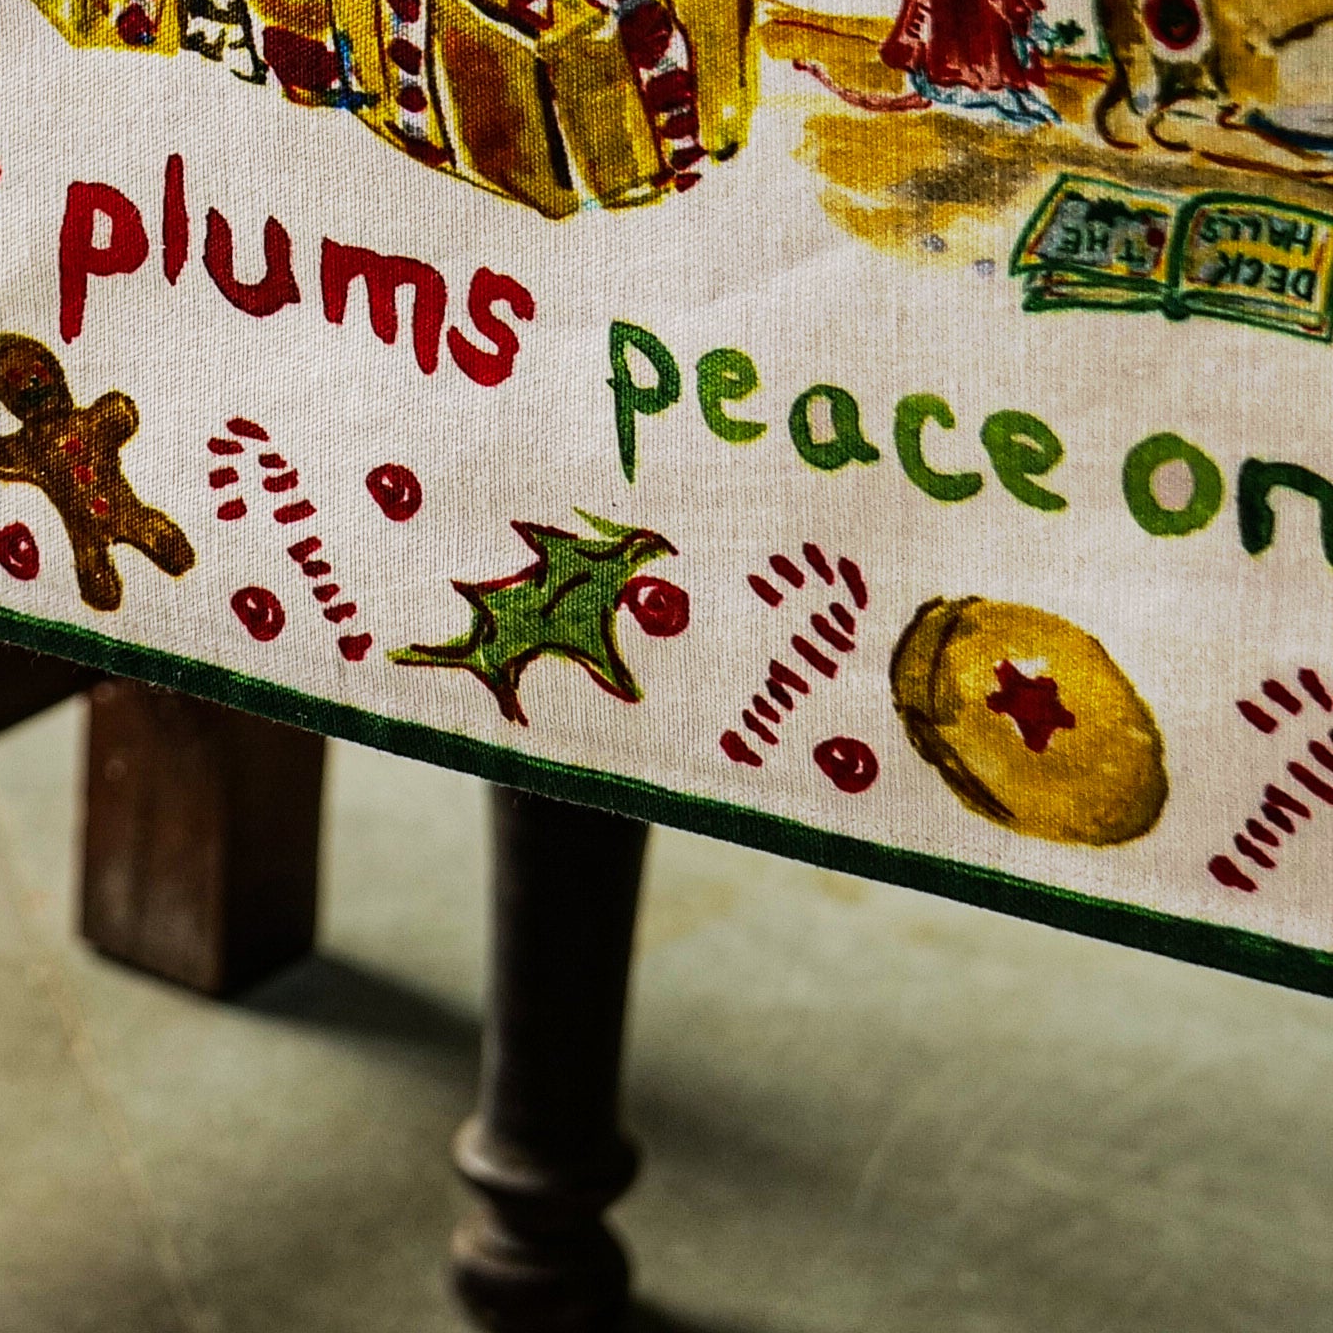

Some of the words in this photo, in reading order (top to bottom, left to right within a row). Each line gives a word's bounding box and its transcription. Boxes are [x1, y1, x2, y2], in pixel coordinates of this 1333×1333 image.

[1057, 223, 1147, 265] THE
[1200, 209, 1314, 256] HALLS
[57, 151, 537, 388] plums
[1211, 249, 1318, 303] DECK
[606, 318, 1068, 513] peace
[1122, 430, 1333, 575] on
